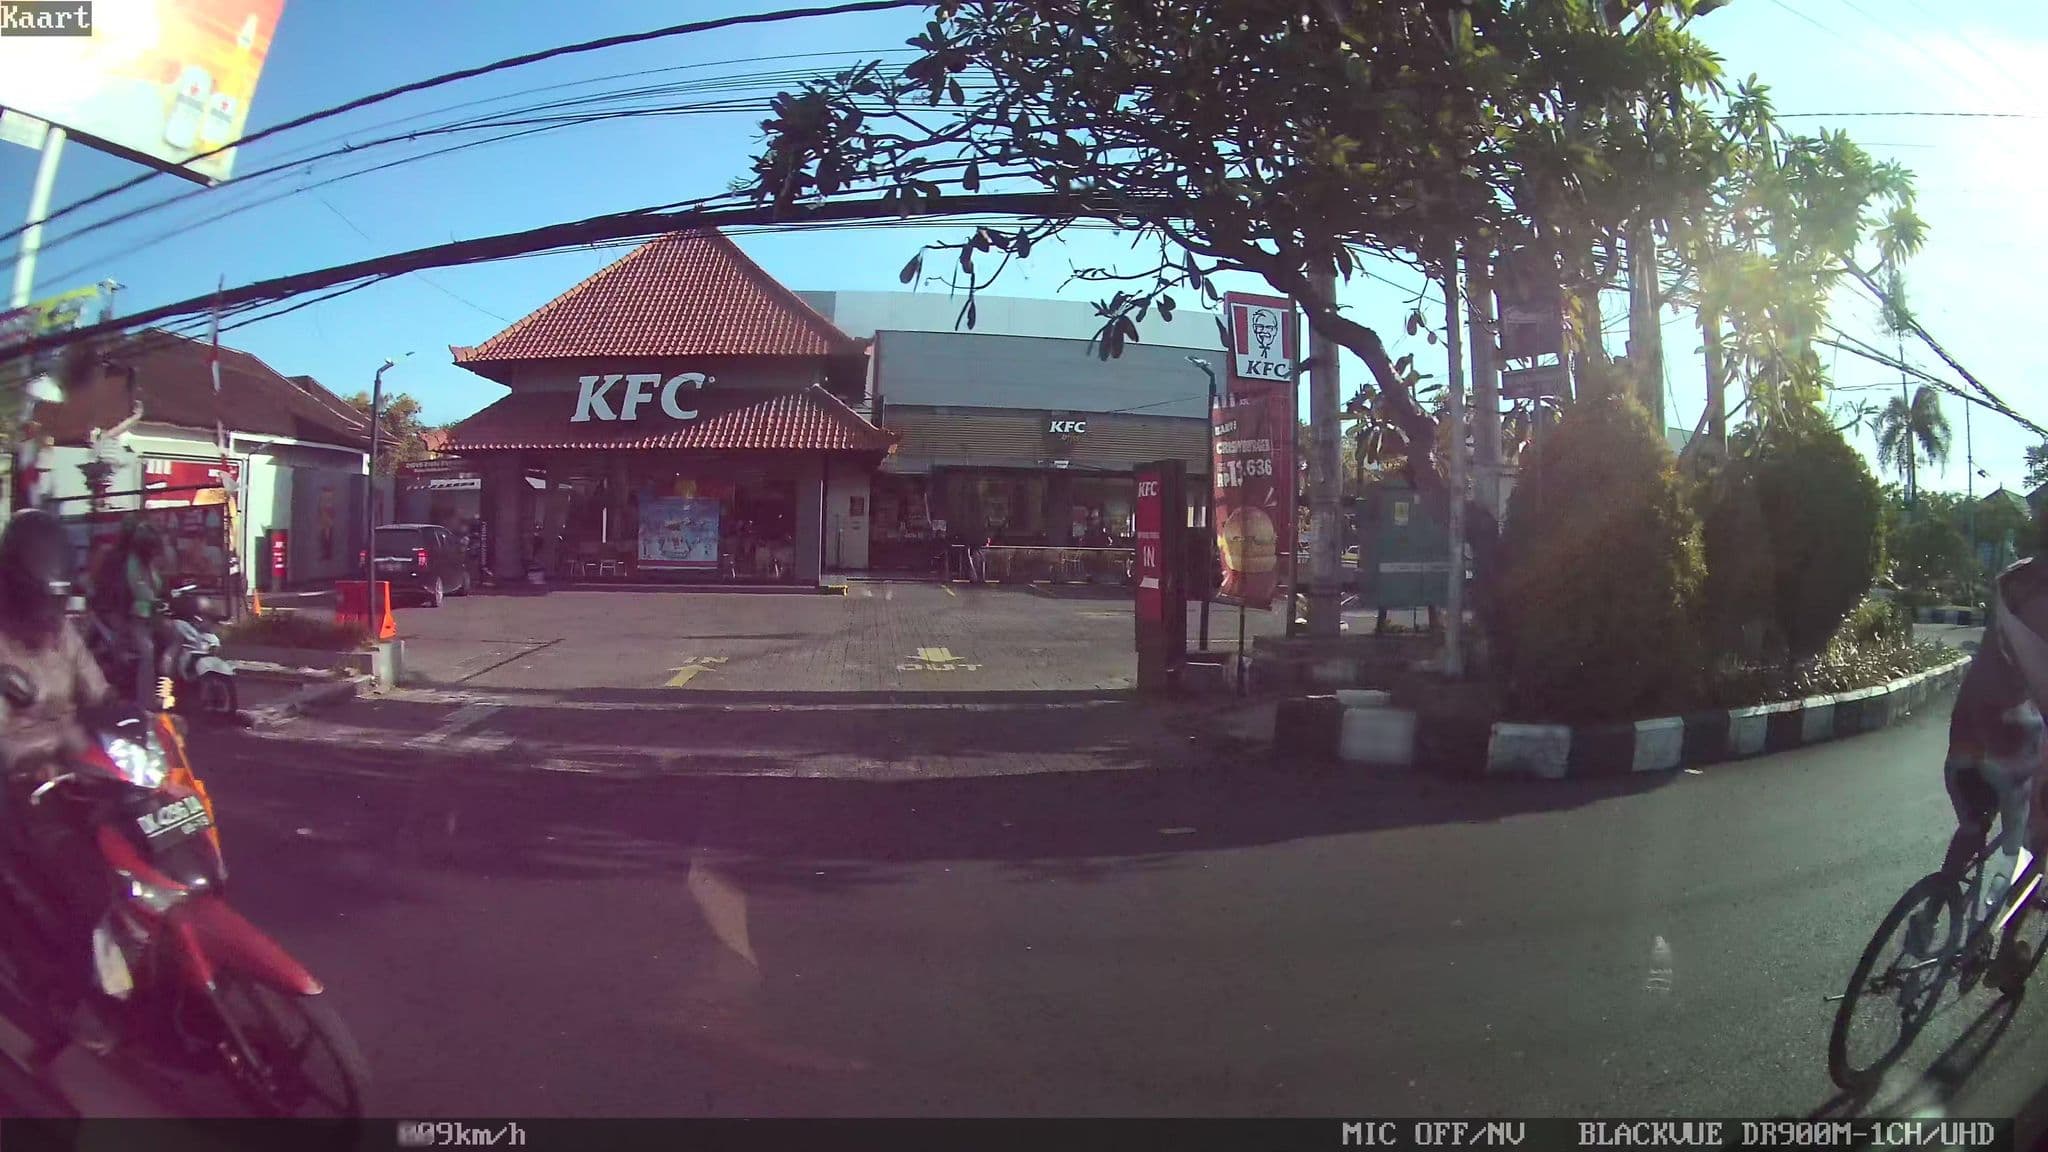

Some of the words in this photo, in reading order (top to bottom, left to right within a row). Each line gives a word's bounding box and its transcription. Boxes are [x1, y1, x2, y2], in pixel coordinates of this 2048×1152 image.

[1246, 359, 1288, 378] KFC
[570, 372, 706, 422] KFC
[1049, 420, 1086, 433] KFC
[1138, 481, 1159, 497] KFC
[1143, 545, 1156, 567] IN
